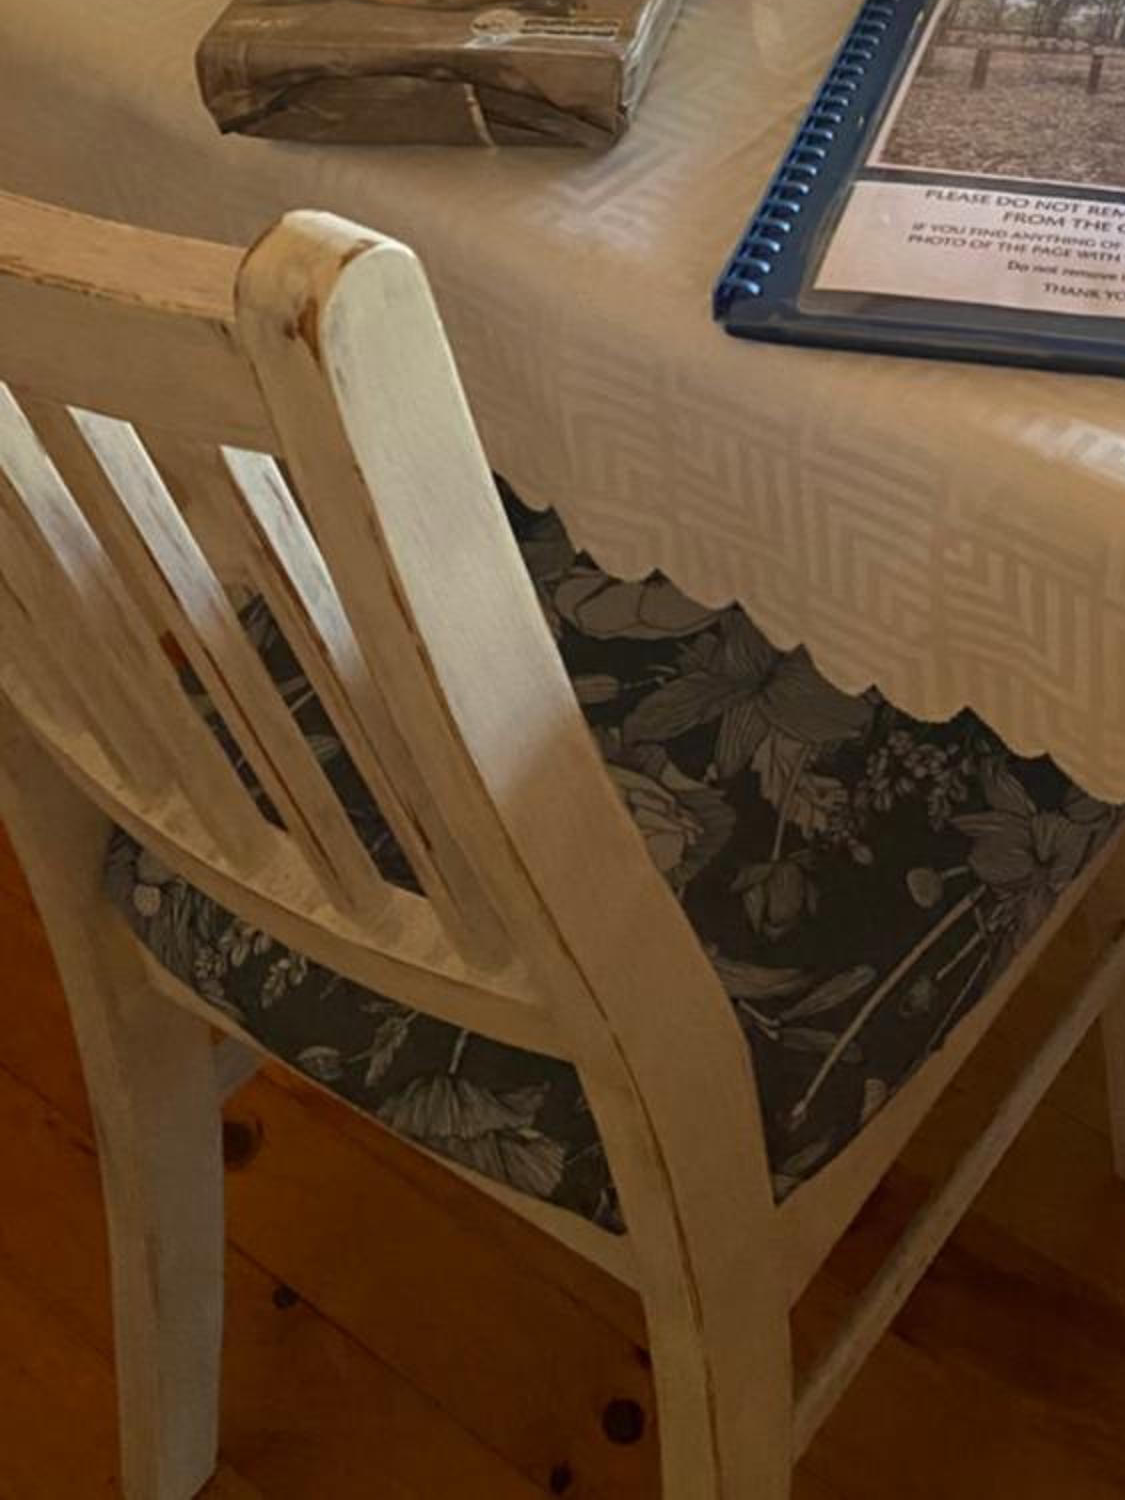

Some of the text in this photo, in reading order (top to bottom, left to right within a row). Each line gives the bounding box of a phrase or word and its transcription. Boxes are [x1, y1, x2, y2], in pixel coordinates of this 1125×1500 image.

[925, 188, 989, 204] PLEASE
[996, 196, 1030, 209] DO
[1034, 199, 1080, 214] NOT
[1002, 211, 1065, 228] FROM
[1071, 219, 1111, 233] THE
[912, 222, 927, 232] IF
[931, 223, 966, 235] YOU
[969, 227, 1008, 239] FIND
[1011, 231, 1097, 248] ANYTHING
[1100, 239, 1121, 250] OF
[907, 234, 967, 249] PHOTO
[969, 238, 990, 250] OF
[997, 241, 1028, 253] THE
[1031, 244, 1071, 258] PAGE
[1076, 249, 1121, 263] WITH
[1007, 260, 1029, 273] Do
[1033, 264, 1058, 275] not
[1062, 268, 1118, 281] remove
[1042, 282, 1100, 300] THANK
